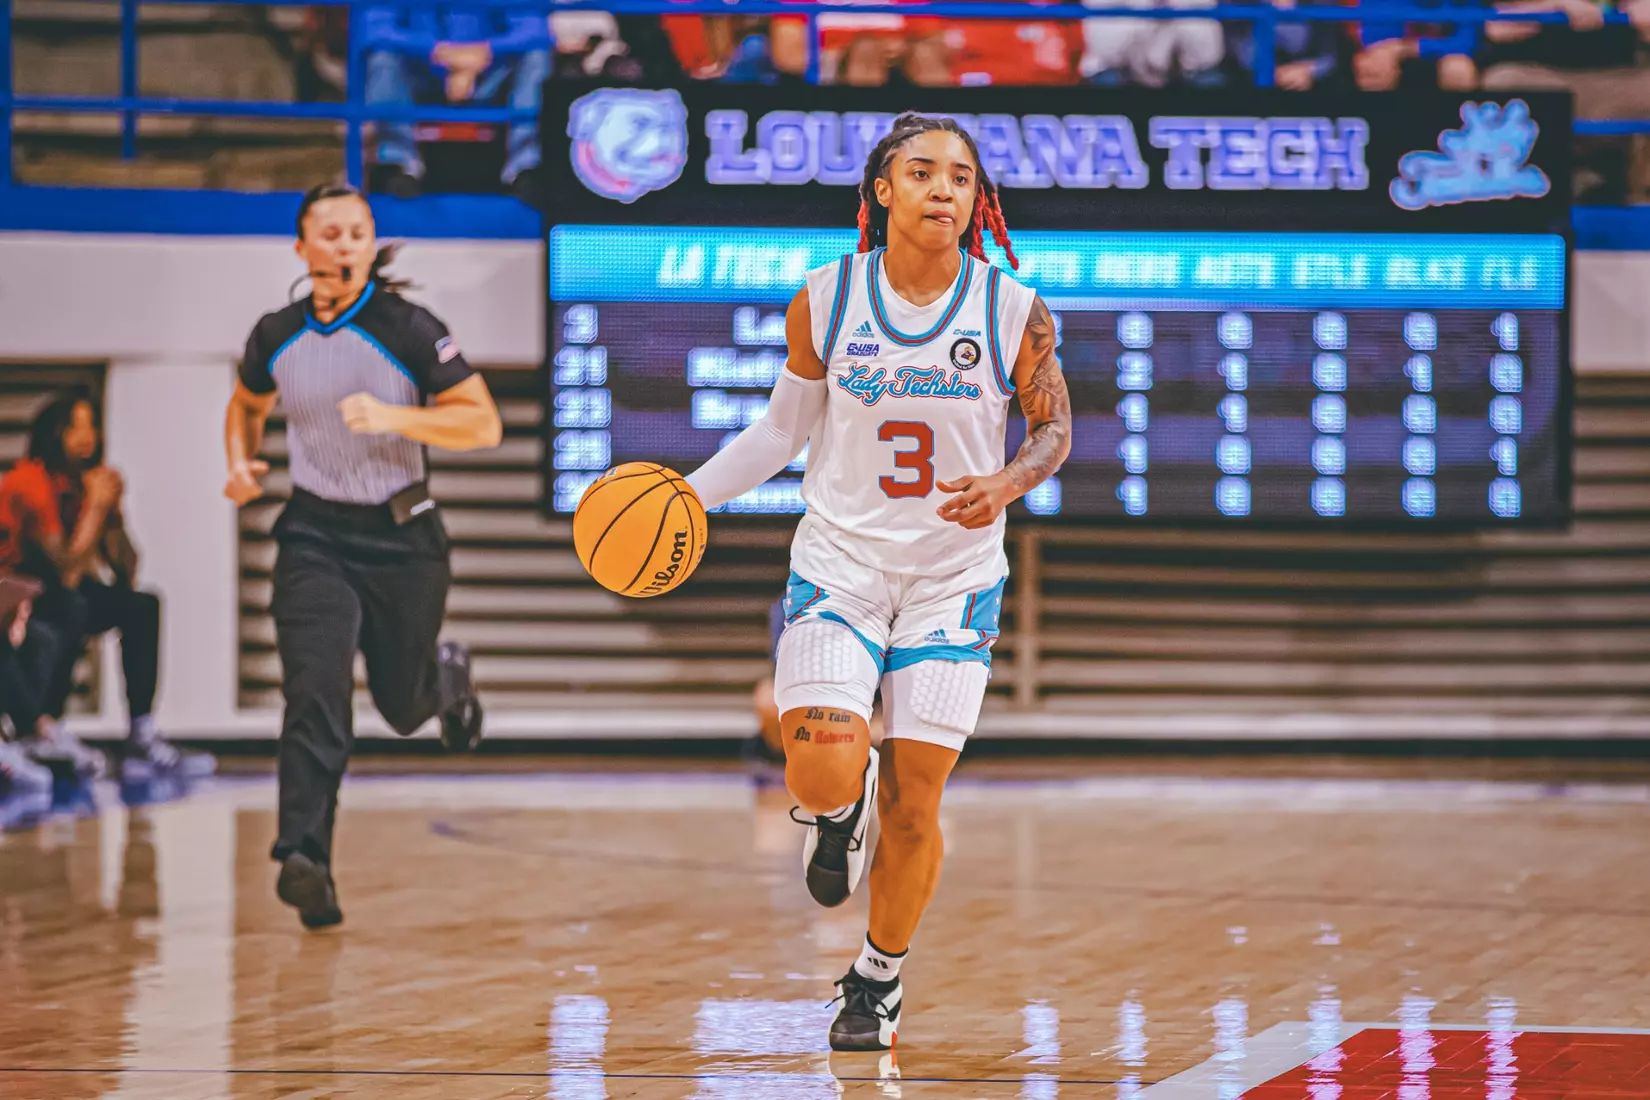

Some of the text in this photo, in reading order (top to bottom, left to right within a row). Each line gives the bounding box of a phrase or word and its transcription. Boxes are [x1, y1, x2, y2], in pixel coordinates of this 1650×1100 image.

[704, 109, 1149, 189] LOUANA
[1149, 117, 1370, 190] TECH
[852, 331, 875, 339] adidas
[837, 362, 983, 407] Lady Techsters
[877, 419, 935, 499] 3
[804, 707, 851, 723] No rain
[793, 726, 811, 742] No
